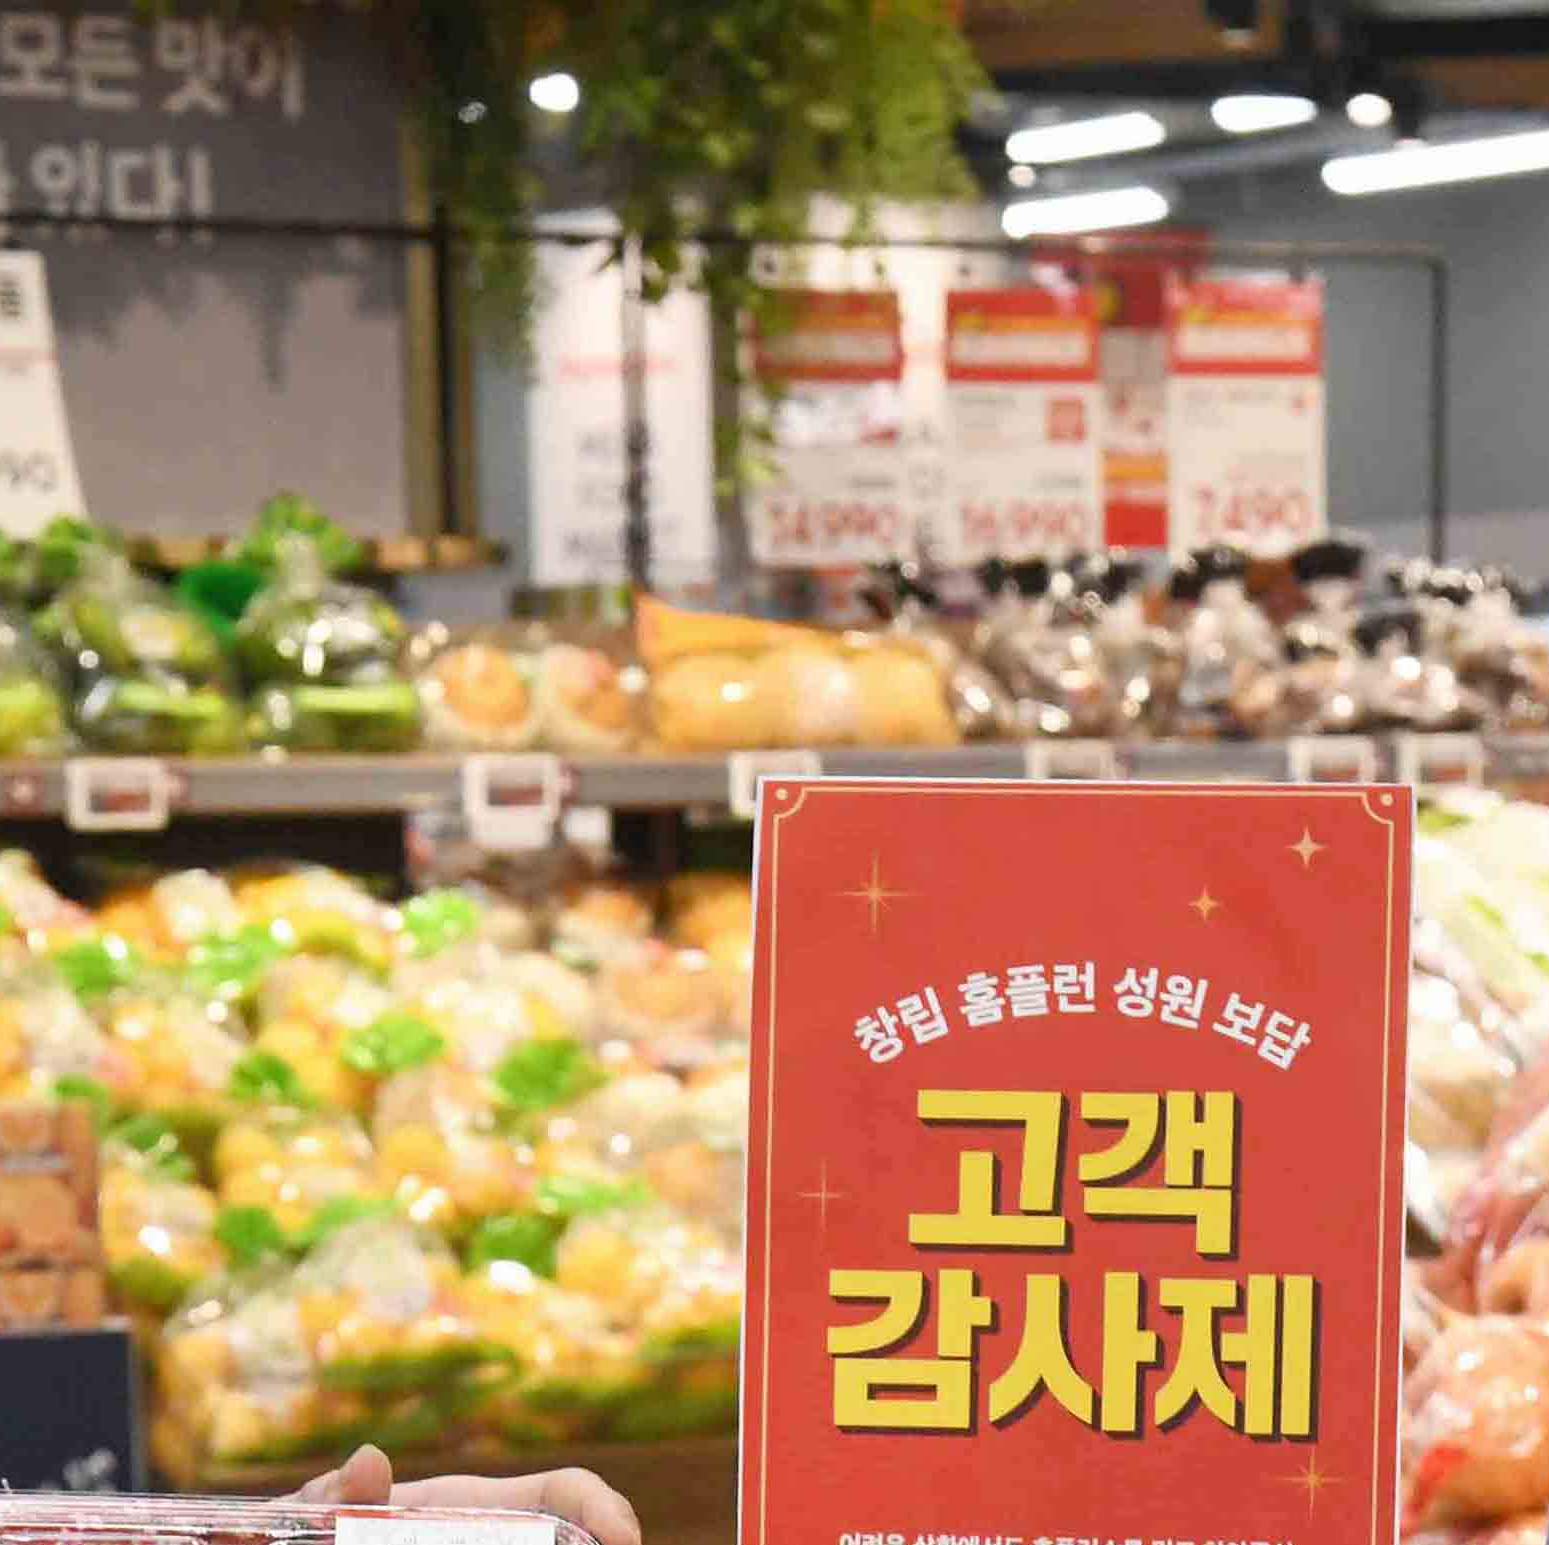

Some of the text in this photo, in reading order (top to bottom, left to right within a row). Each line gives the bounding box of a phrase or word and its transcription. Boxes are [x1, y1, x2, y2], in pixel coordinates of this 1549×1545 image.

[154, 18, 304, 125] 맛이
[853, 961, 1314, 1070] 창립 홈플런 성원 보답
[908, 1088, 1239, 1260] 고객
[826, 1268, 1320, 1441] 감사제
